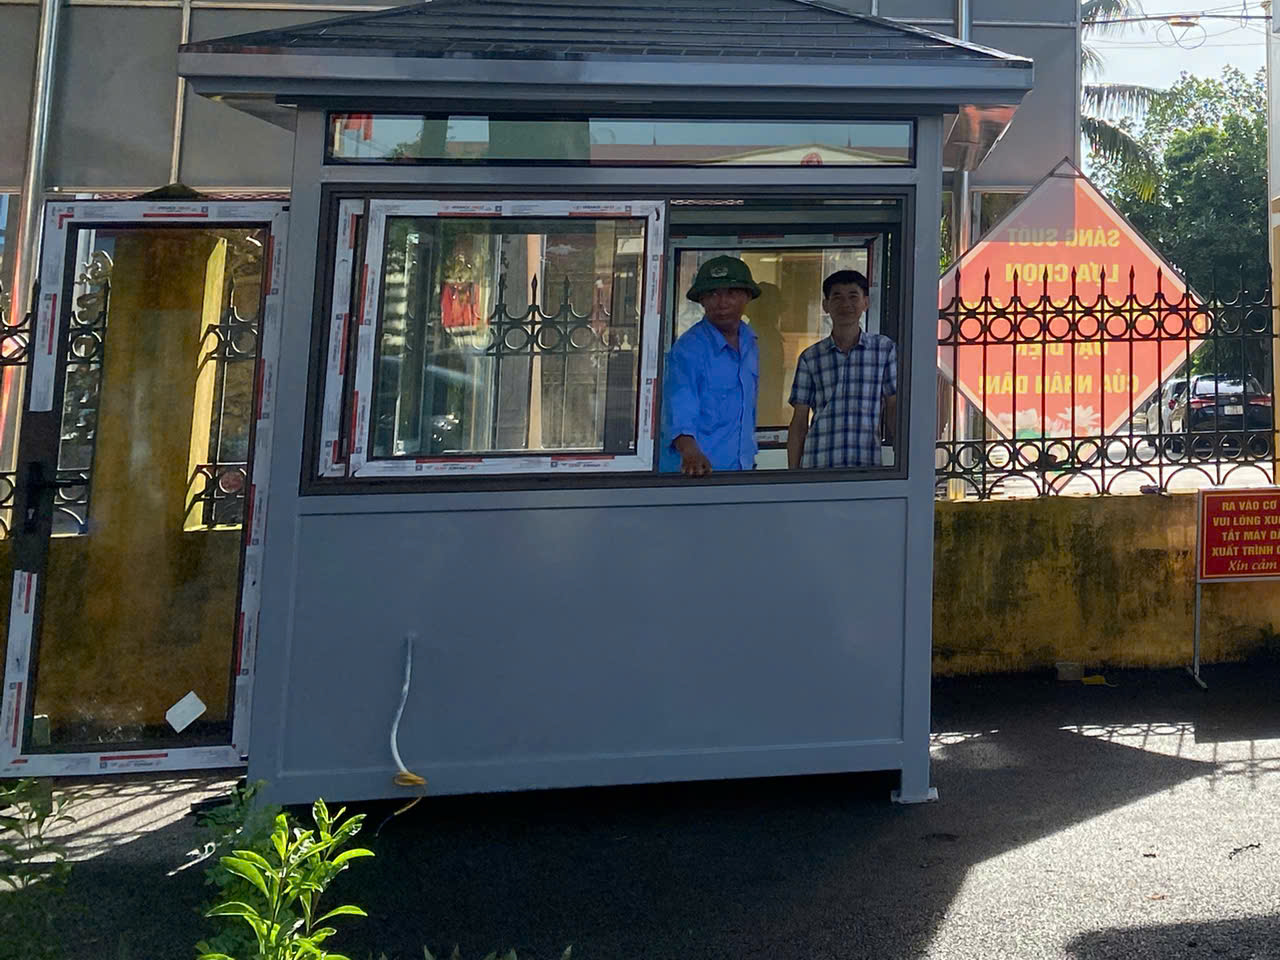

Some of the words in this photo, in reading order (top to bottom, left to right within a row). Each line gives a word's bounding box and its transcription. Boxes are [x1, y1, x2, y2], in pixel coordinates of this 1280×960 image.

[1222, 501, 1236, 511] RA
[1239, 499, 1259, 510] VÀO
[1263, 499, 1277, 510] CƠ
[1213, 516, 1230, 526] VUI
[1233, 514, 1261, 526] LÒNG
[1243, 528, 1267, 540] MÁY
[1242, 544, 1273, 556] TRÌNH
[1228, 560, 1249, 571] Xin
[1251, 559, 1277, 571] cảm
